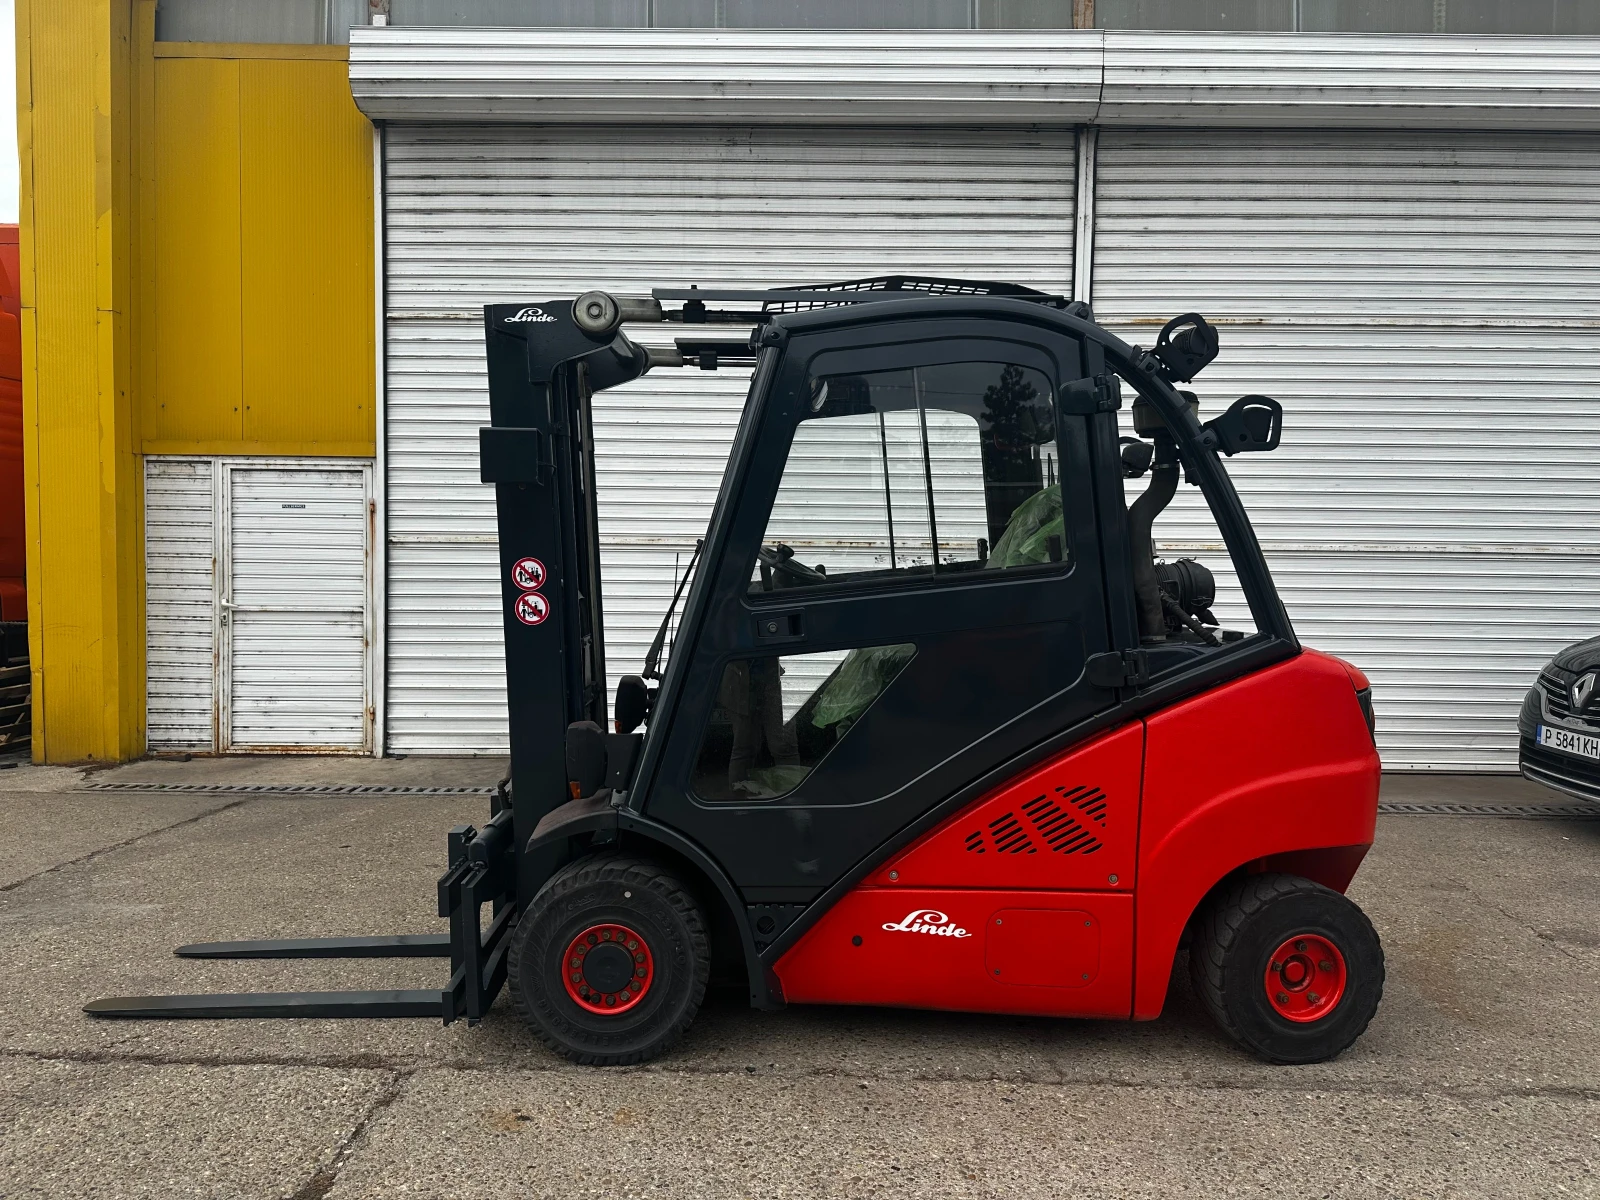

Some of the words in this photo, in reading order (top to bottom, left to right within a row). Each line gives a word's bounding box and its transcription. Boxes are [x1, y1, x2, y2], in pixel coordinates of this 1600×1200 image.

[504, 307, 557, 322] Linde
[1545, 729, 1552, 743] P
[1556, 731, 1581, 752] 5841
[881, 909, 973, 938] Linde
